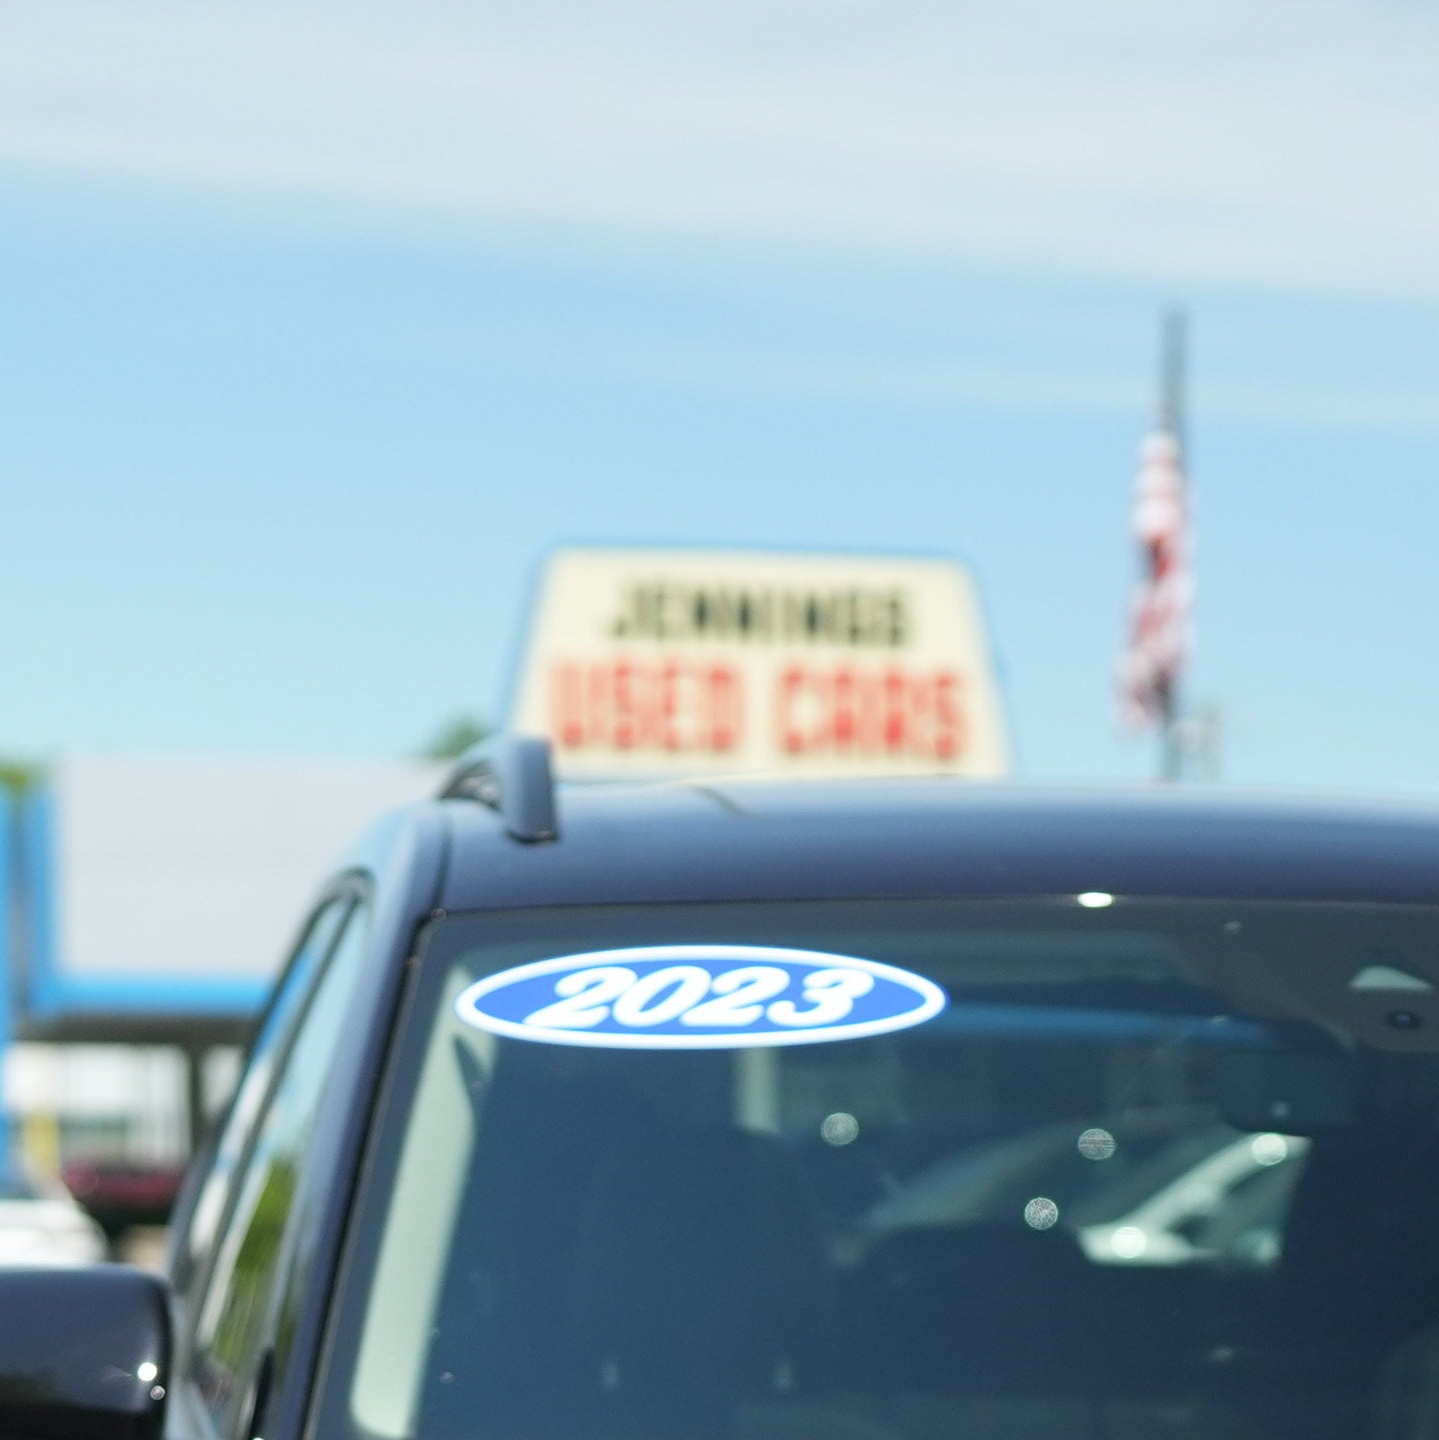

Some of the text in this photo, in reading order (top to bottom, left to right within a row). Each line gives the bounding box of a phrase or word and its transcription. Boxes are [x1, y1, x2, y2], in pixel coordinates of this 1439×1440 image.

[606, 582, 911, 646] JENNINGS
[551, 660, 965, 756] USED CARS
[523, 966, 875, 1028] 2023
